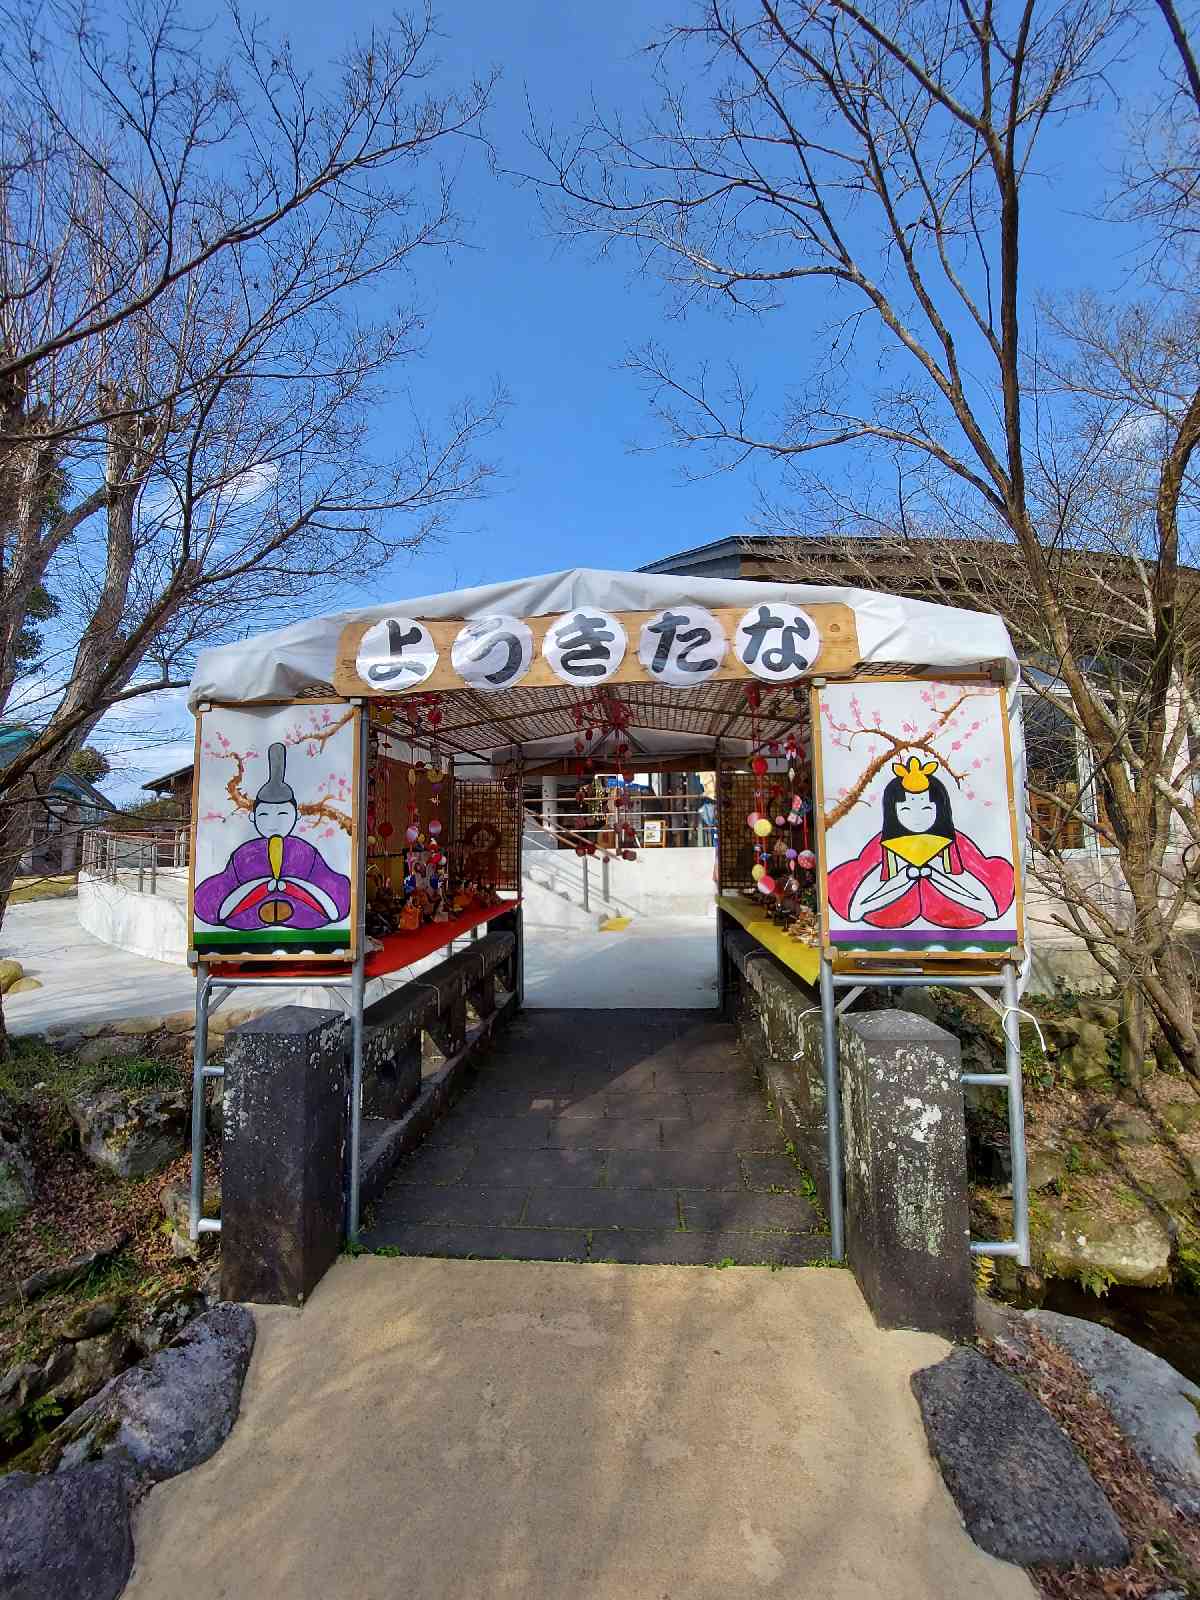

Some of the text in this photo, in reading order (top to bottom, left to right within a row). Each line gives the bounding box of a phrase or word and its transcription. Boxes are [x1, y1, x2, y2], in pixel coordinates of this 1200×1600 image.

[367, 606, 810, 684] ようきたな
